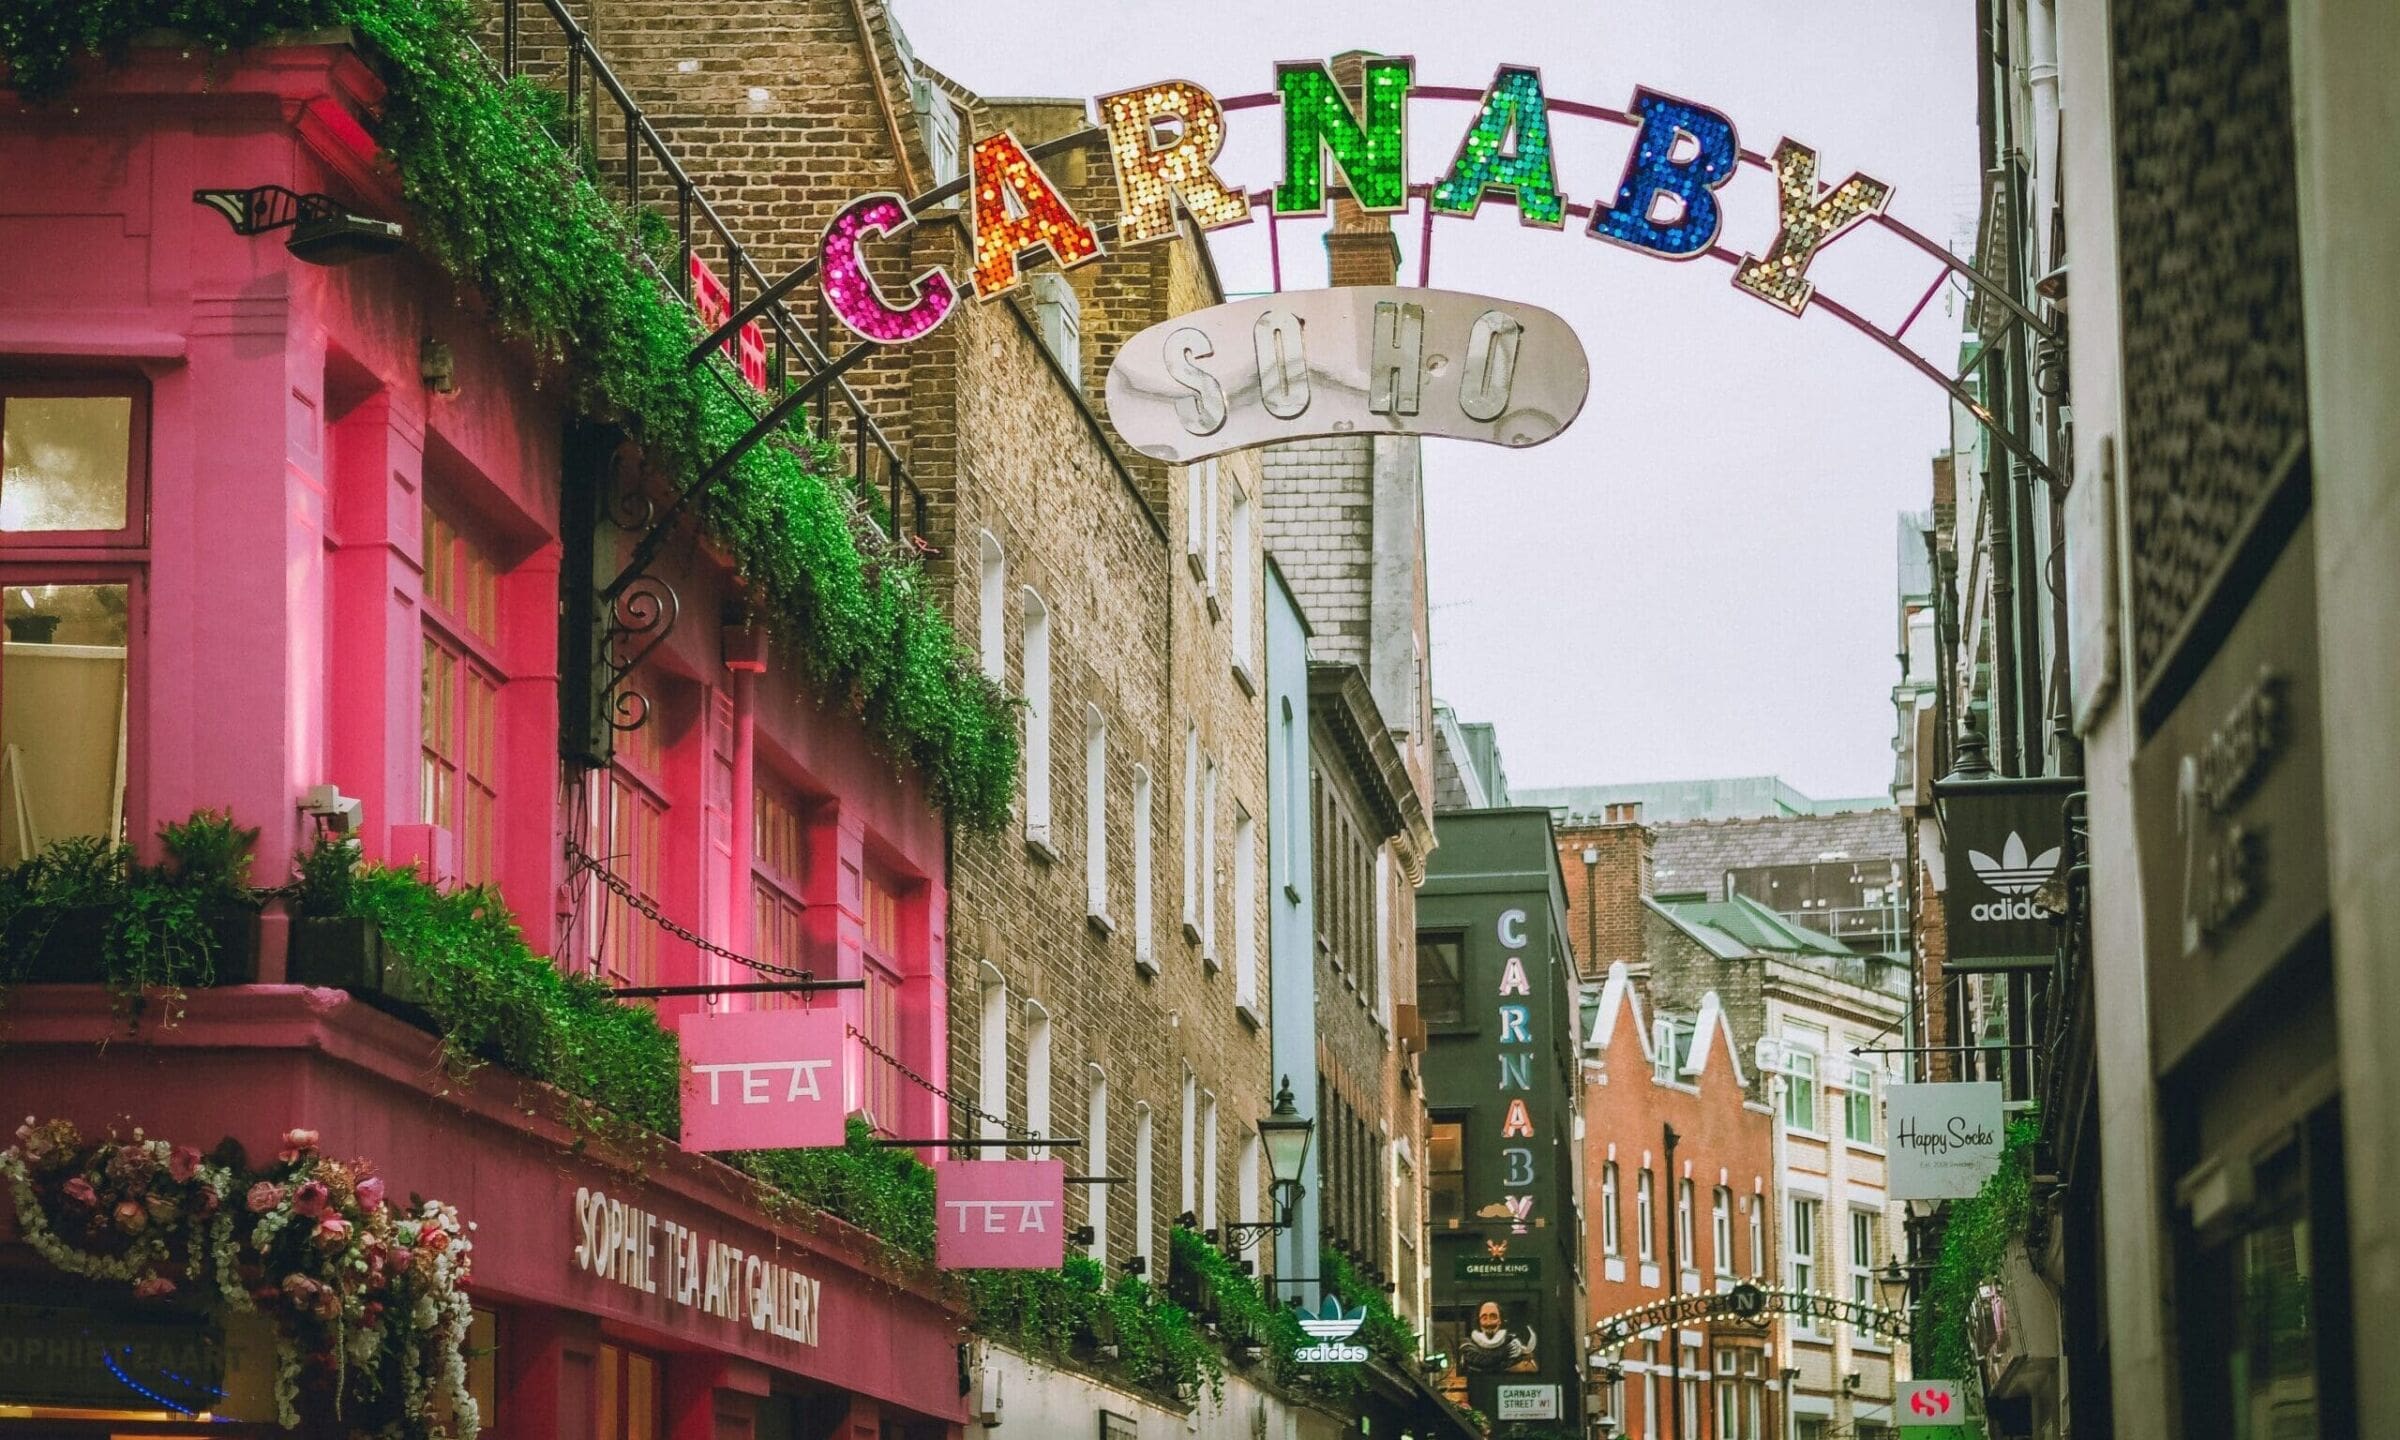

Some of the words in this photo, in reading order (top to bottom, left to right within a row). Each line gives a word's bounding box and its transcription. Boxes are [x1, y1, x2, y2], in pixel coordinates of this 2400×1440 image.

[820, 55, 1896, 344] CARNABY
[1162, 302, 1525, 437] SOHO
[1971, 897, 2049, 921] adida
[691, 1060, 832, 1105] TEA
[1497, 909, 1534, 1234] CARNABY
[944, 1201, 1055, 1233] TEA
[575, 1187, 657, 1294] SOPHIE
[665, 1220, 701, 1309] TEA
[703, 1239, 743, 1322] ART
[745, 1254, 821, 1348] GALLERY
[1466, 1264, 1502, 1273] GREENE
[1505, 1264, 1529, 1273] KING
[1296, 1343, 1366, 1361] adidas
[1503, 1390, 1541, 1398] CARNABY
[1504, 1400, 1534, 1408] STREET
[1539, 1400, 1550, 1408] W1
